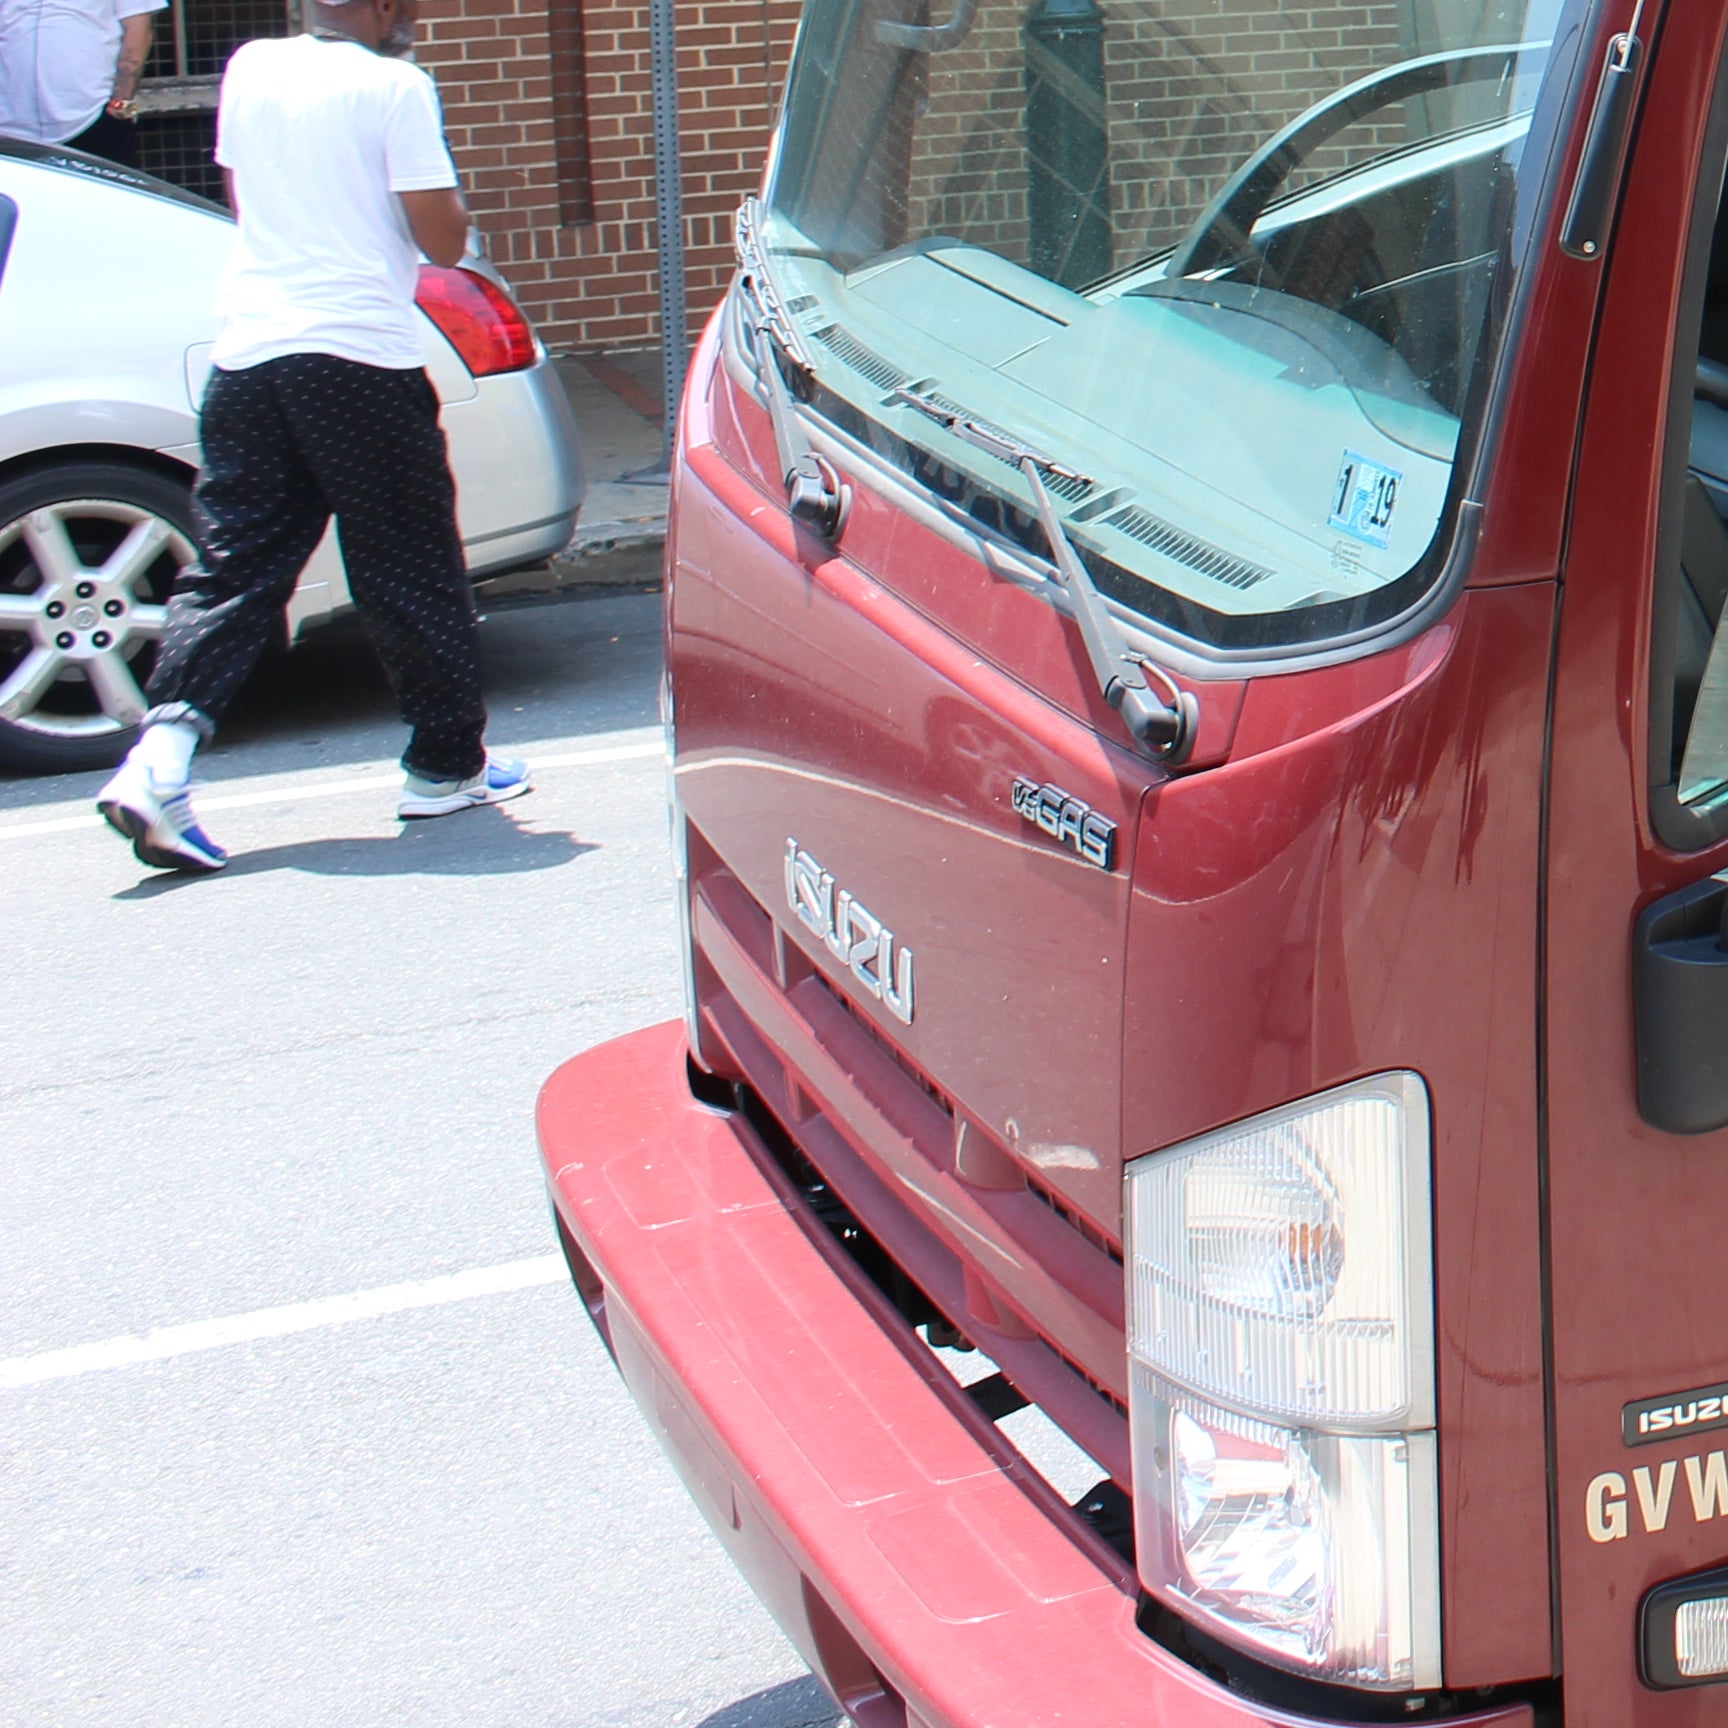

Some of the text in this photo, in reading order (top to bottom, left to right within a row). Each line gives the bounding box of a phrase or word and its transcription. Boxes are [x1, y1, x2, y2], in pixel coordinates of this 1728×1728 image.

[1337, 463, 1398, 528] 1 19
[1036, 783, 1117, 870] GAS
[784, 837, 915, 1025] ISUZU
